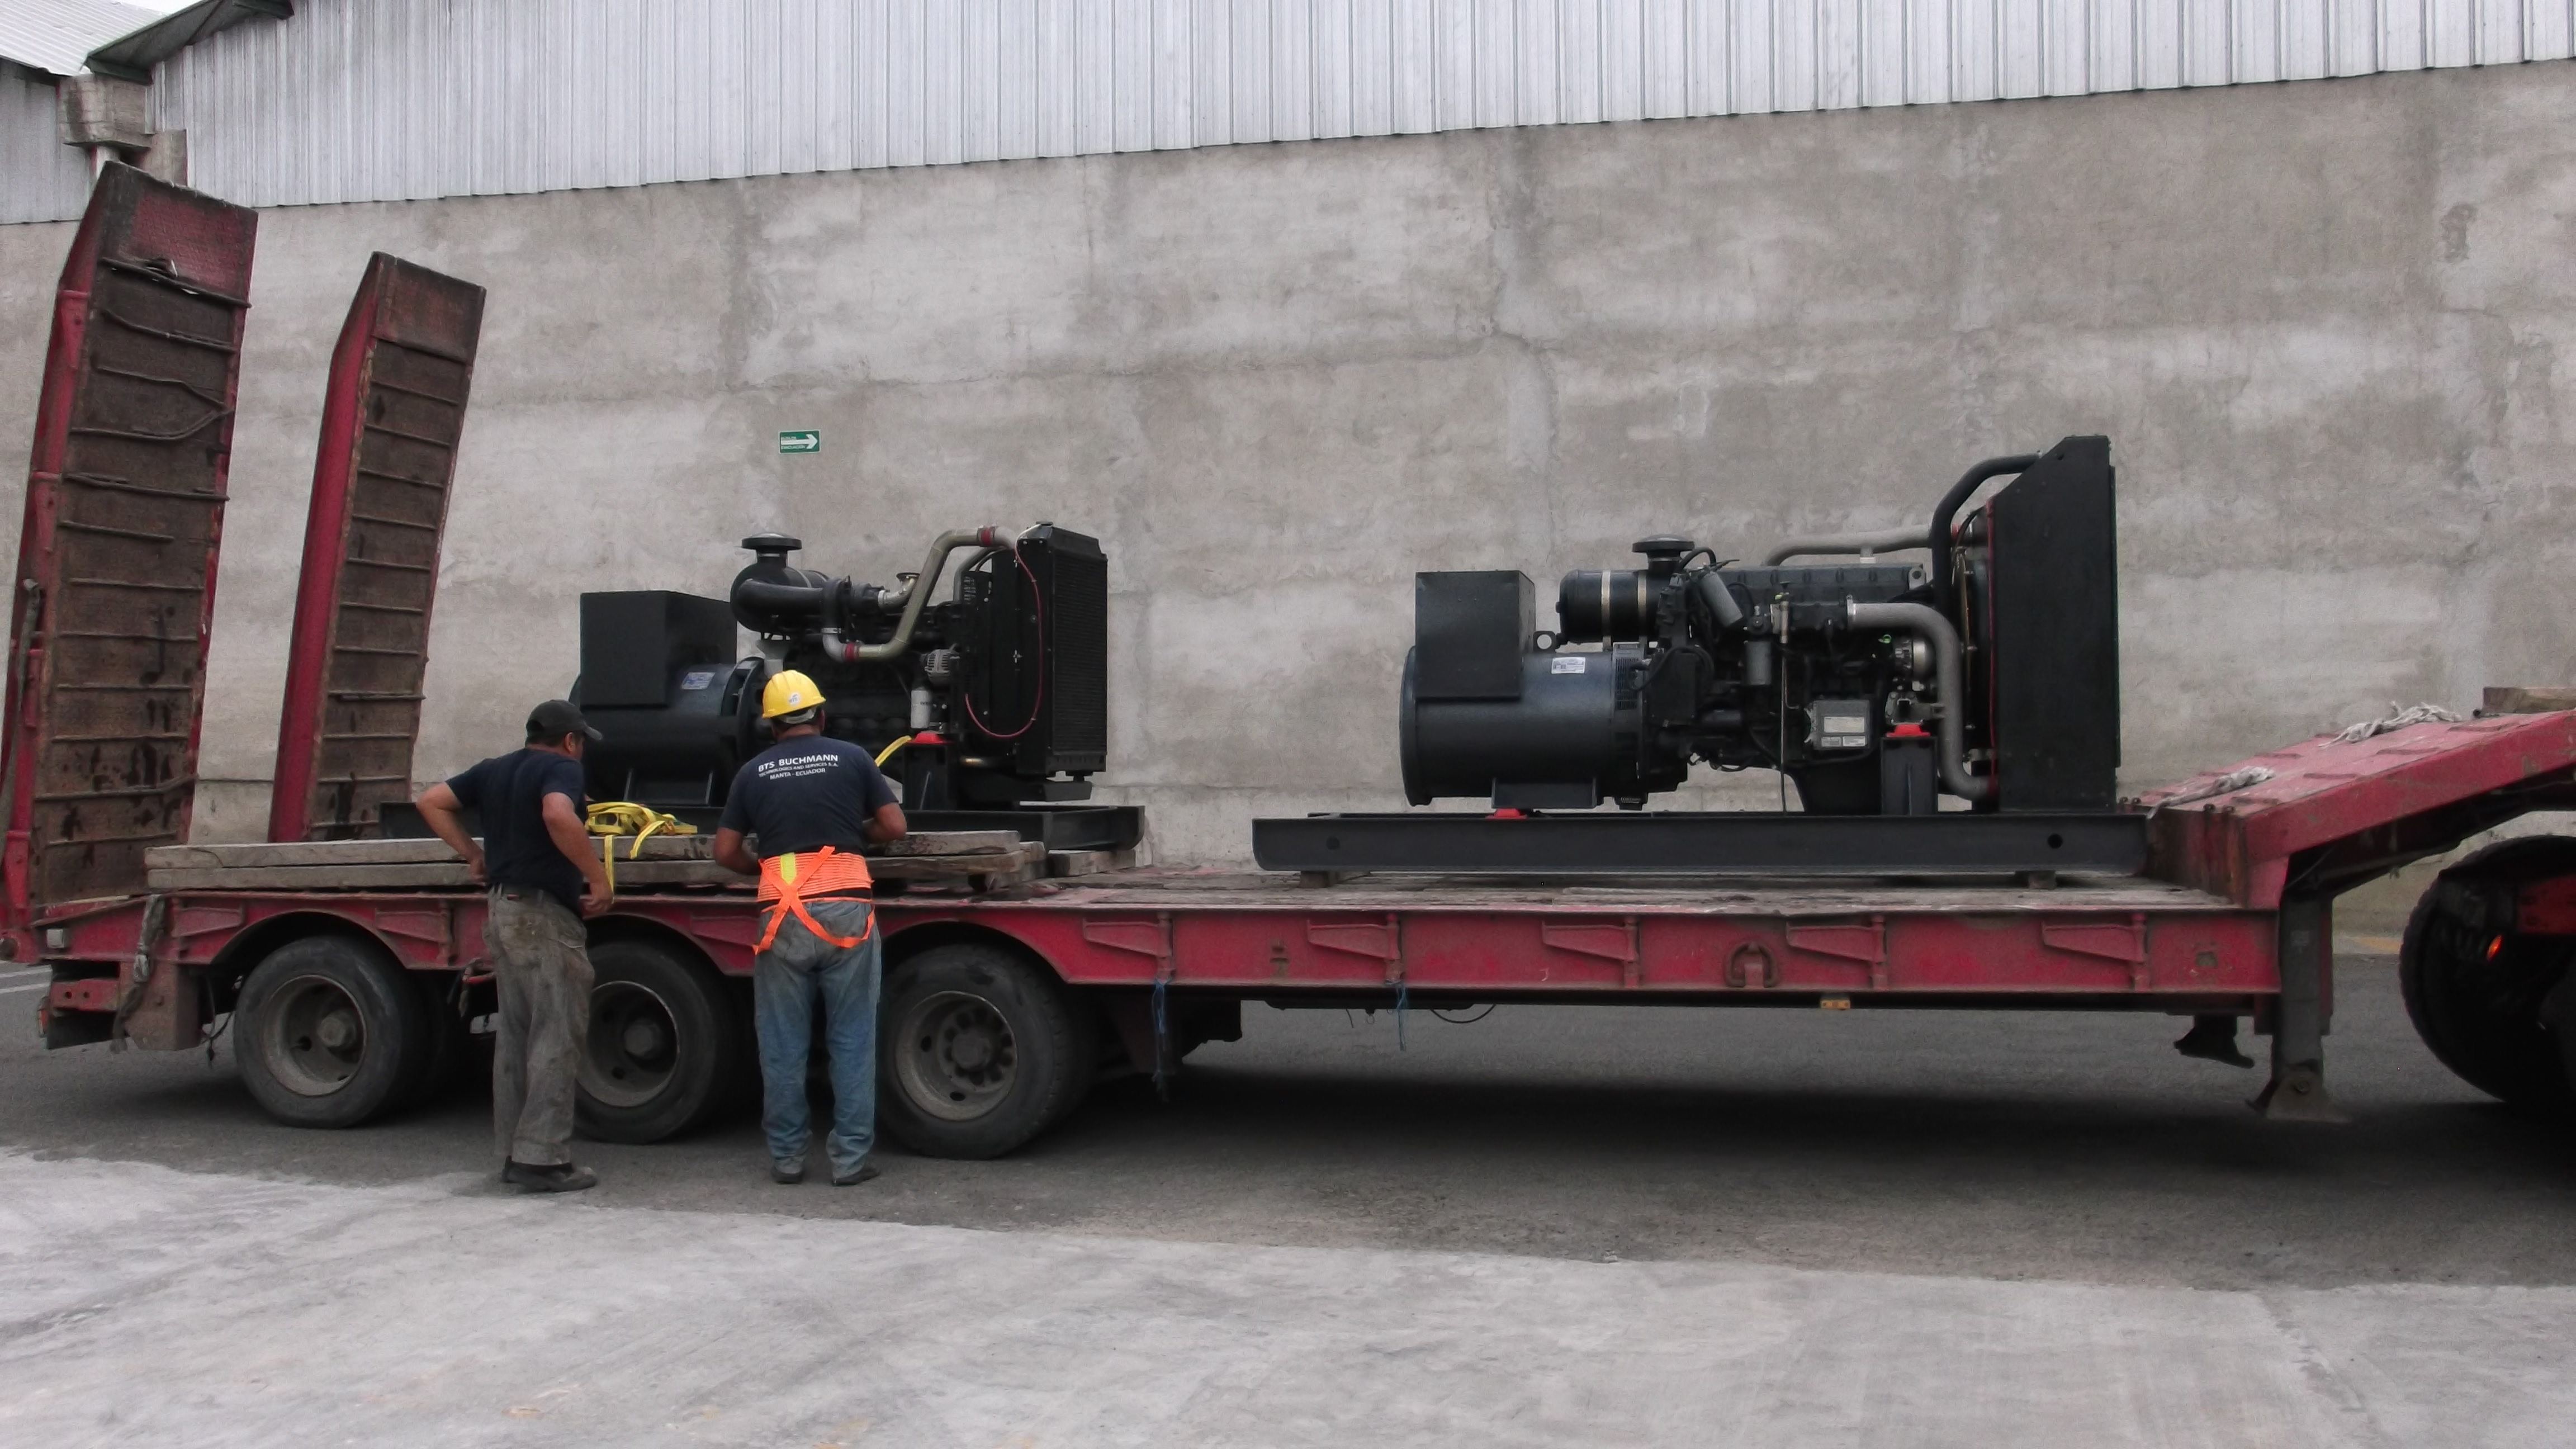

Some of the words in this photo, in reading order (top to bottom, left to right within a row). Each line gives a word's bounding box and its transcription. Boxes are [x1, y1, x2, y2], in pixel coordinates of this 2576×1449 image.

[759, 761, 775, 772] BTS
[779, 754, 838, 766] BUCHMANN
[770, 771, 791, 780] MANTA
[795, 768, 826, 776] ECUADOR
